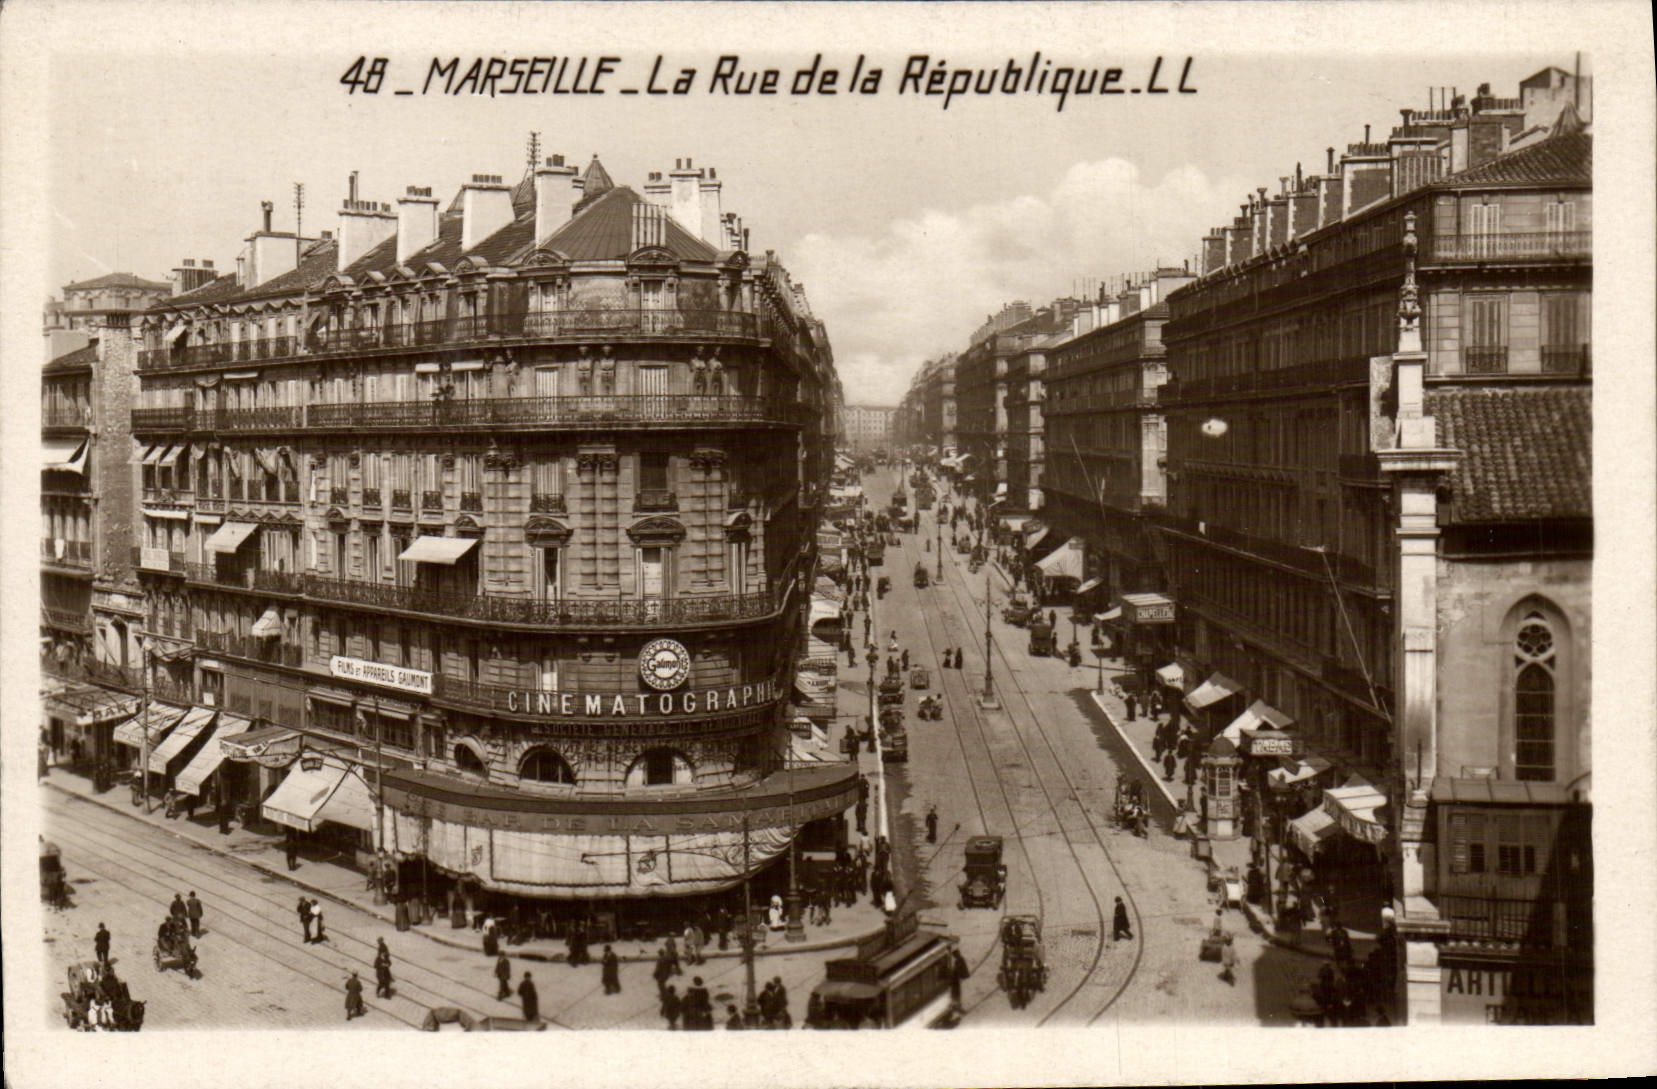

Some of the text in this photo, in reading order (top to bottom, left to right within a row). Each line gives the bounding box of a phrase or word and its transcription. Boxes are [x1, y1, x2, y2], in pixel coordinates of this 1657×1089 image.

[337, 660, 354, 675] FILMS
[363, 664, 395, 683] APPAREILS
[398, 670, 428, 691] GAUMONT
[544, 815, 585, 831] DE
[607, 815, 658, 832] LA
